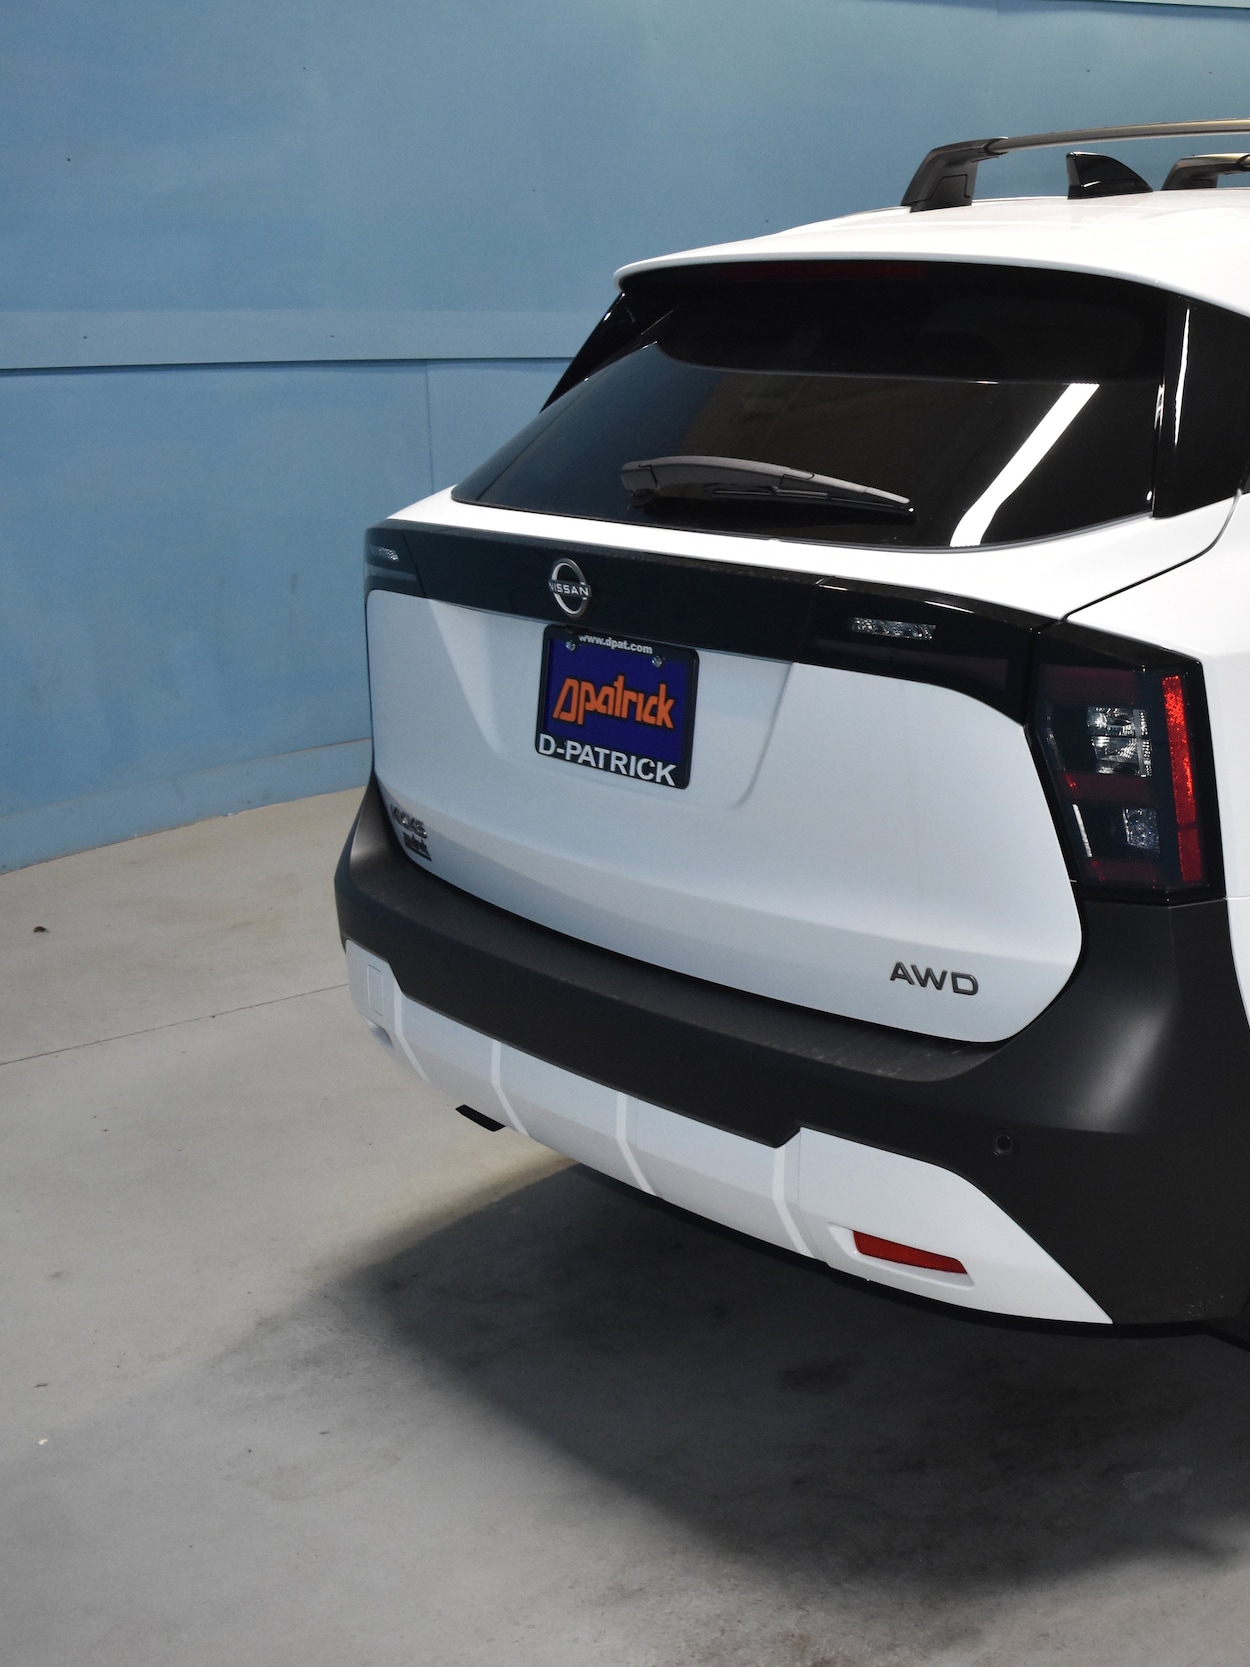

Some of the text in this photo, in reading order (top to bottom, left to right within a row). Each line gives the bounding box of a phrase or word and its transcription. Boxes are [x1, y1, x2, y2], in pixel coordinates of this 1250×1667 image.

[548, 582, 589, 596] NISSAN
[579, 634, 654, 655] www.dpat.com
[538, 733, 677, 787] D-PATRICK
[889, 961, 979, 996] AWD
